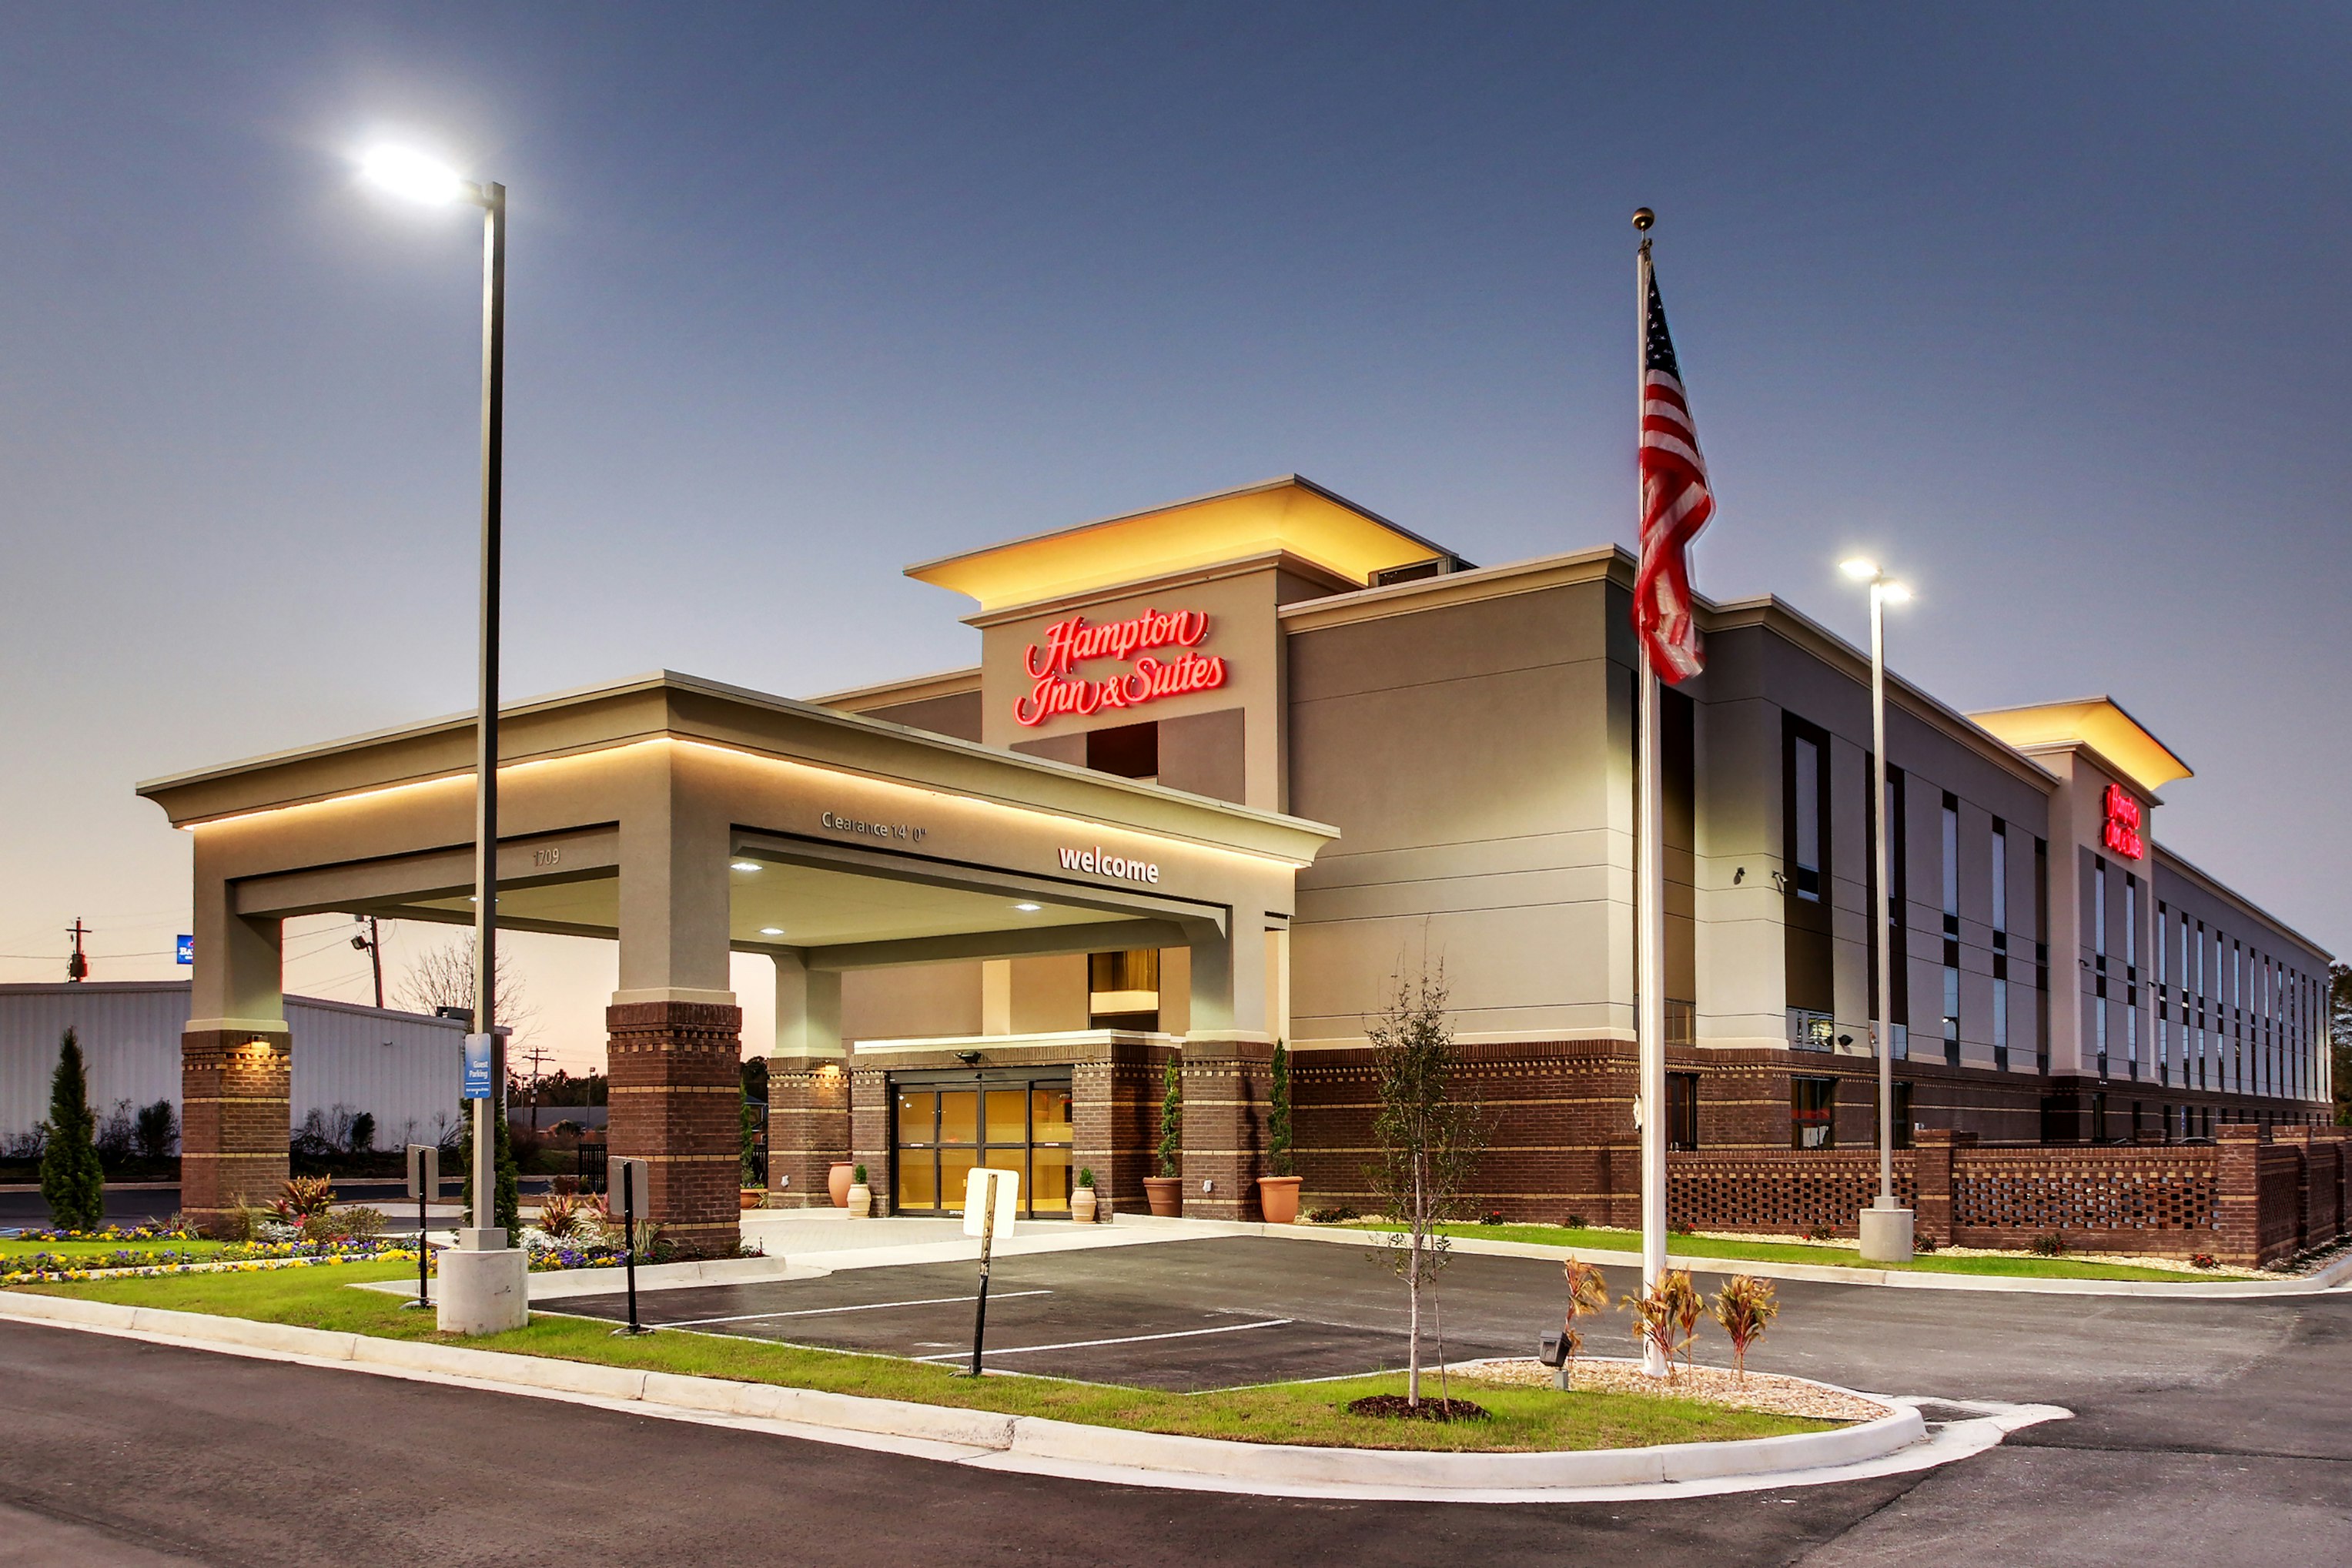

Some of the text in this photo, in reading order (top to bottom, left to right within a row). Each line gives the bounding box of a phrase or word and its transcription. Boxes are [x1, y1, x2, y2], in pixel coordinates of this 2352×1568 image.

[1024, 607, 1209, 679] Hampton
[1013, 651, 1227, 727] Inn & Suites
[821, 811, 888, 837] Clearance
[533, 848, 560, 867] 1709
[1058, 845, 1159, 884] welcome
[468, 1069, 489, 1080] Parking
[473, 1060, 489, 1068] Guest
